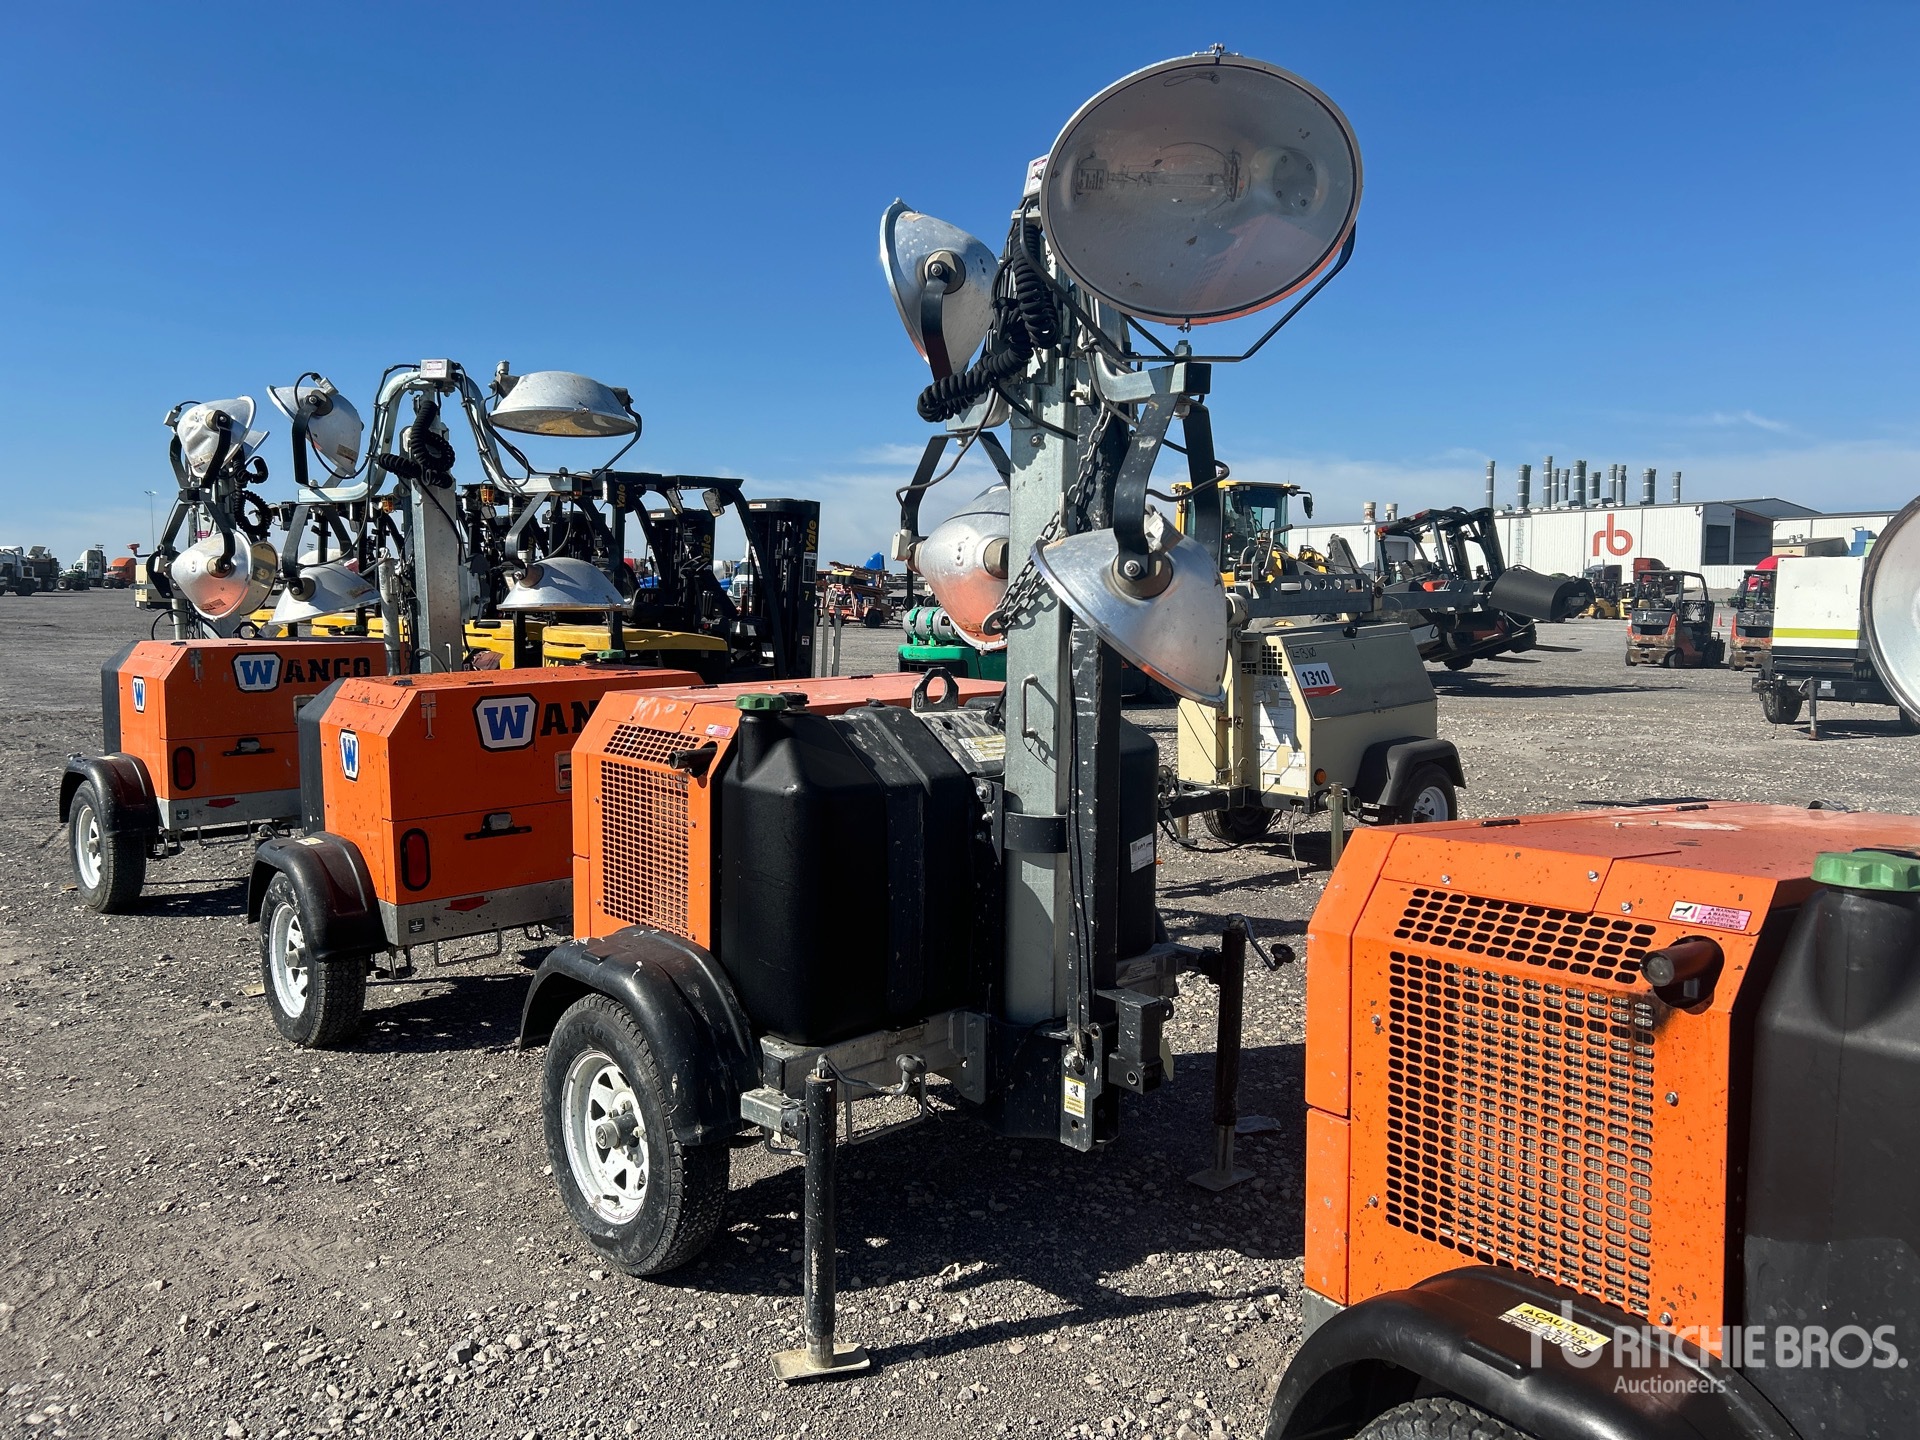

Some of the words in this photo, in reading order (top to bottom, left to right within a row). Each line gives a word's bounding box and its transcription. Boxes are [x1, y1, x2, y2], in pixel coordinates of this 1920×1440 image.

[616, 483, 627, 508] Yale
[805, 519, 818, 553] Yale
[1592, 513, 1634, 557] rb
[239, 657, 371, 685] WANCO
[545, 658, 565, 668] Yal
[1301, 669, 1330, 686] 1310
[133, 682, 144, 707] W
[342, 737, 357, 773] W
[1516, 1313, 1544, 1327] NOT
[1535, 1312, 1599, 1342] CAUTION
[1542, 1332, 1562, 1345] 35
[1560, 1341, 1587, 1355] PSI
